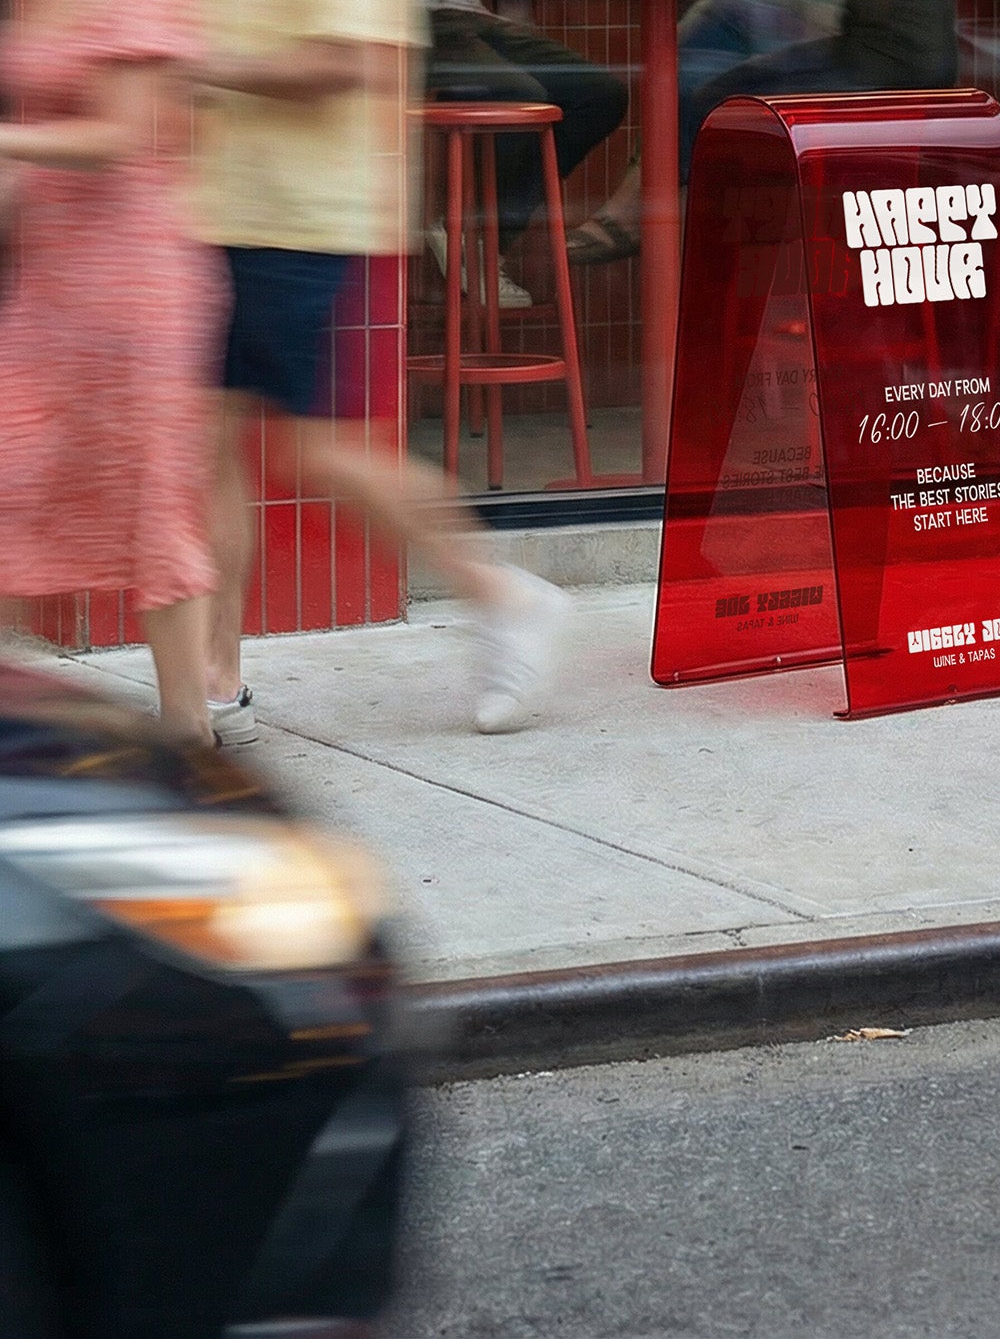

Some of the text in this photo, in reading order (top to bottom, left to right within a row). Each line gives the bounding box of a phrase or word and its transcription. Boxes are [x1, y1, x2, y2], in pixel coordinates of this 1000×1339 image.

[842, 183, 999, 249] HAPPY
[859, 242, 987, 307] HOUR
[884, 377, 991, 403] EVERY DAY FROM
[858, 410, 920, 444] 16:00
[916, 462, 976, 484] BECAUSE
[890, 492, 916, 510] THE
[919, 488, 951, 507] BEST
[913, 507, 989, 531] START HERE
[907, 622, 977, 654] WIGGLY
[933, 648, 996, 668] WINE & TAPAS
